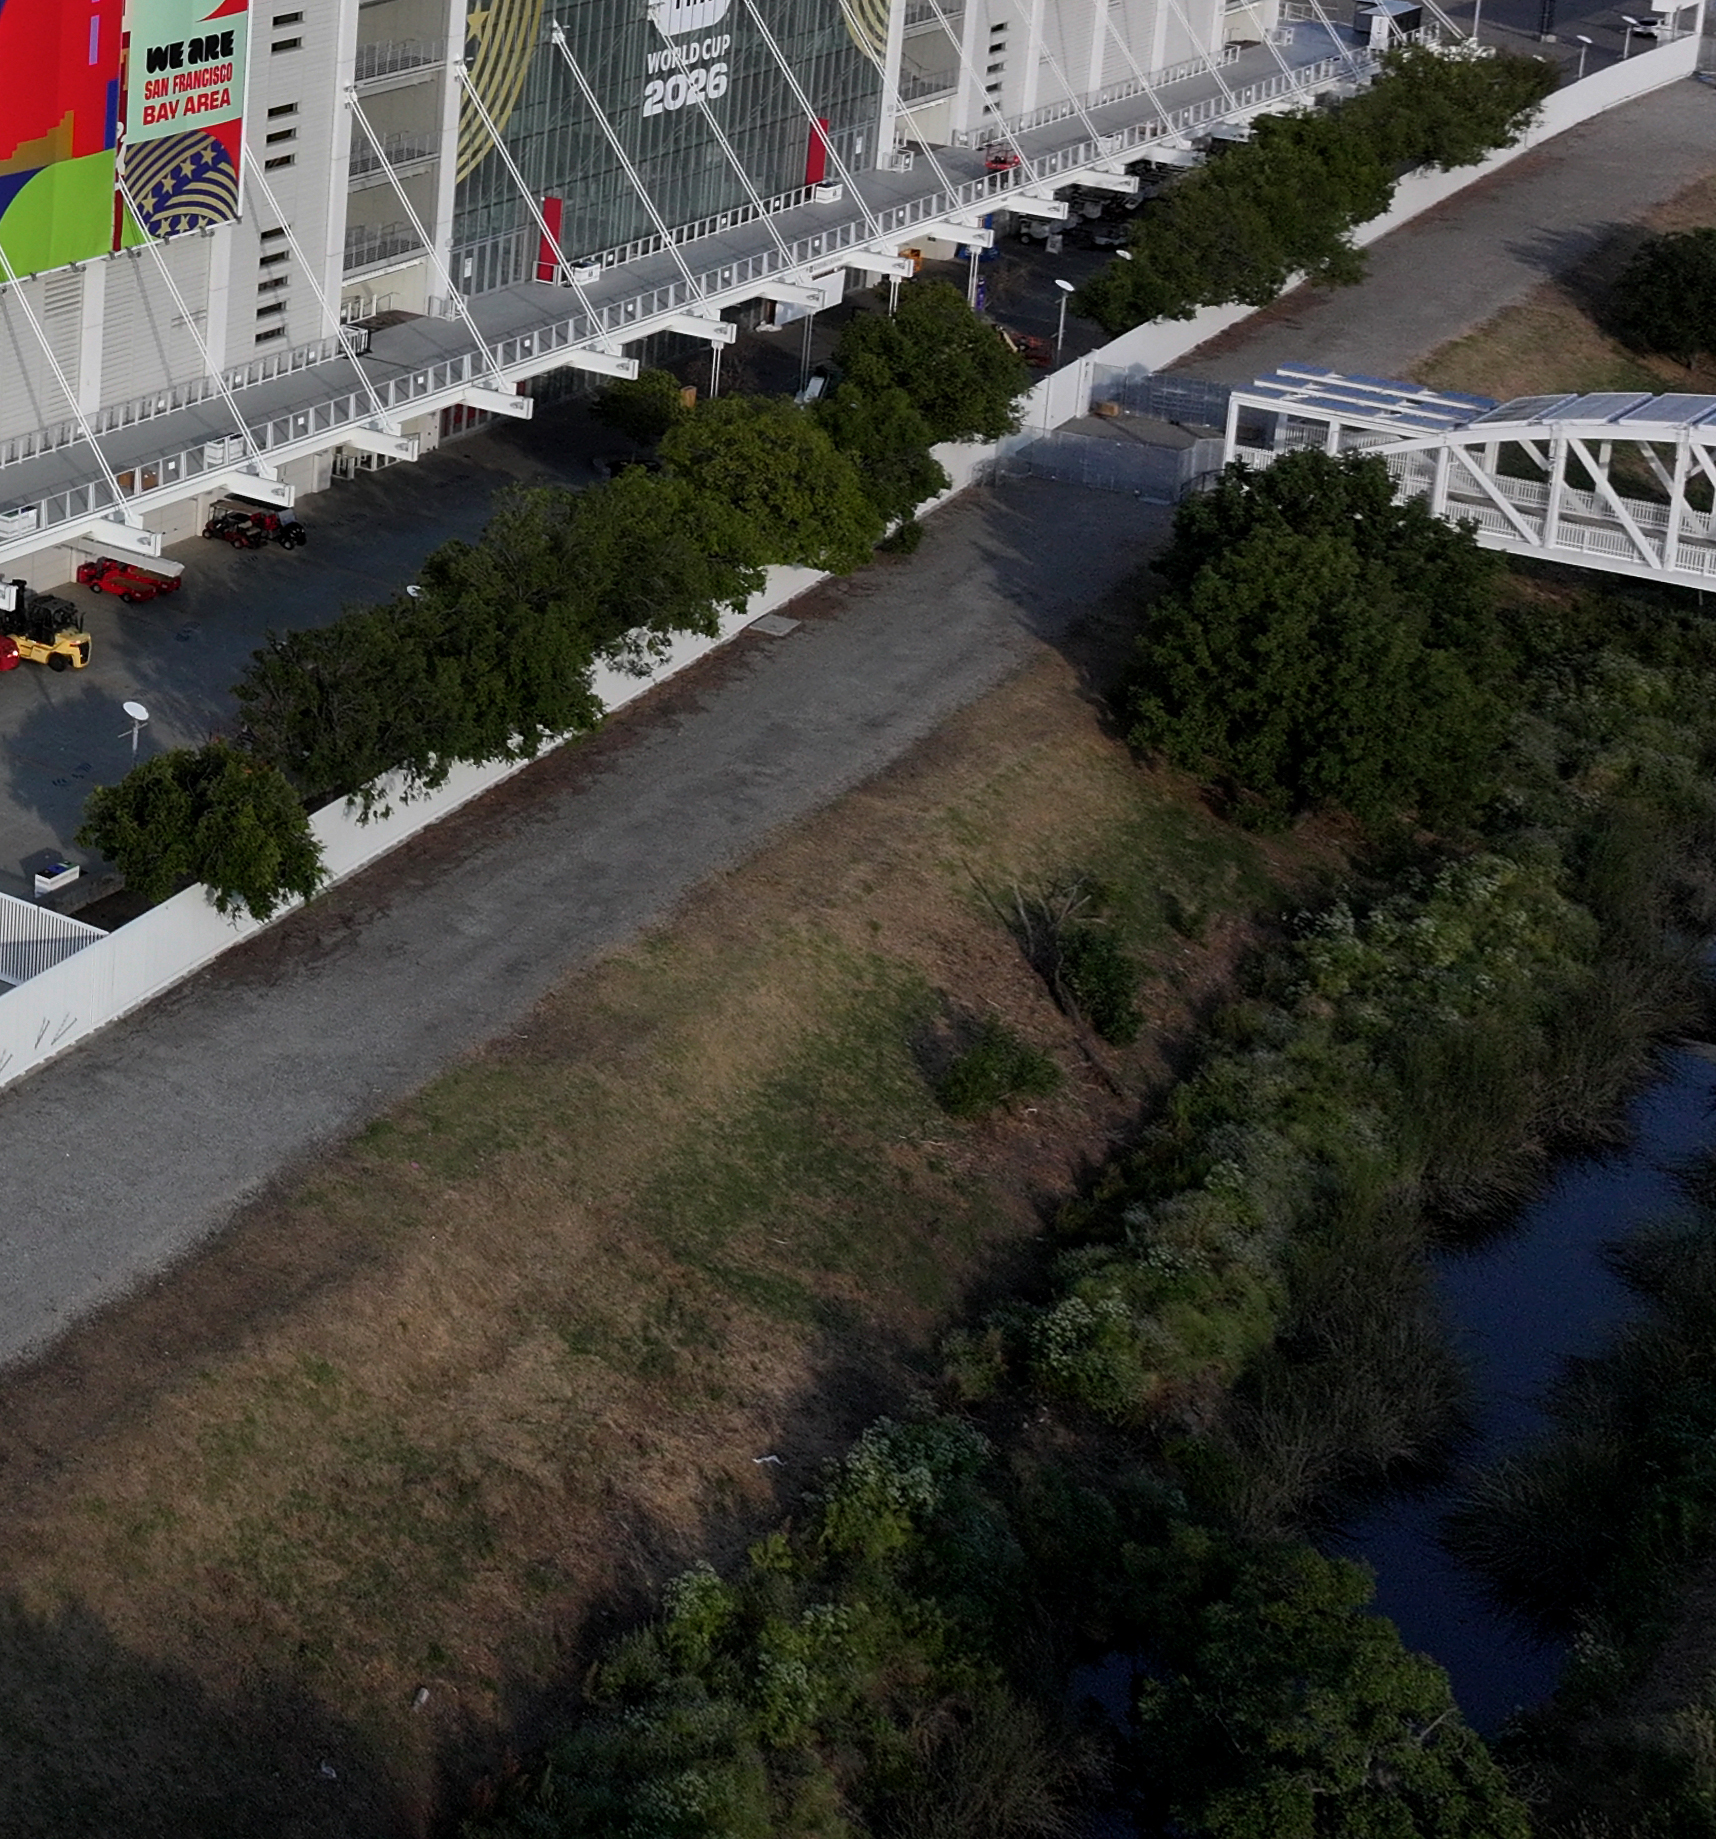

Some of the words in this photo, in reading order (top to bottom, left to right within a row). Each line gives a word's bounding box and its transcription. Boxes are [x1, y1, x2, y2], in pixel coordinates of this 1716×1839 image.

[146, 41, 185, 74] WE
[187, 30, 235, 65] ARE
[648, 42, 700, 75] WORLD
[702, 34, 731, 60] CUP
[144, 77, 170, 100] SAN
[172, 62, 233, 95] FRANCISCO
[643, 62, 728, 117] 2026
[143, 99, 180, 125] BAY
[183, 88, 232, 116] AREA
